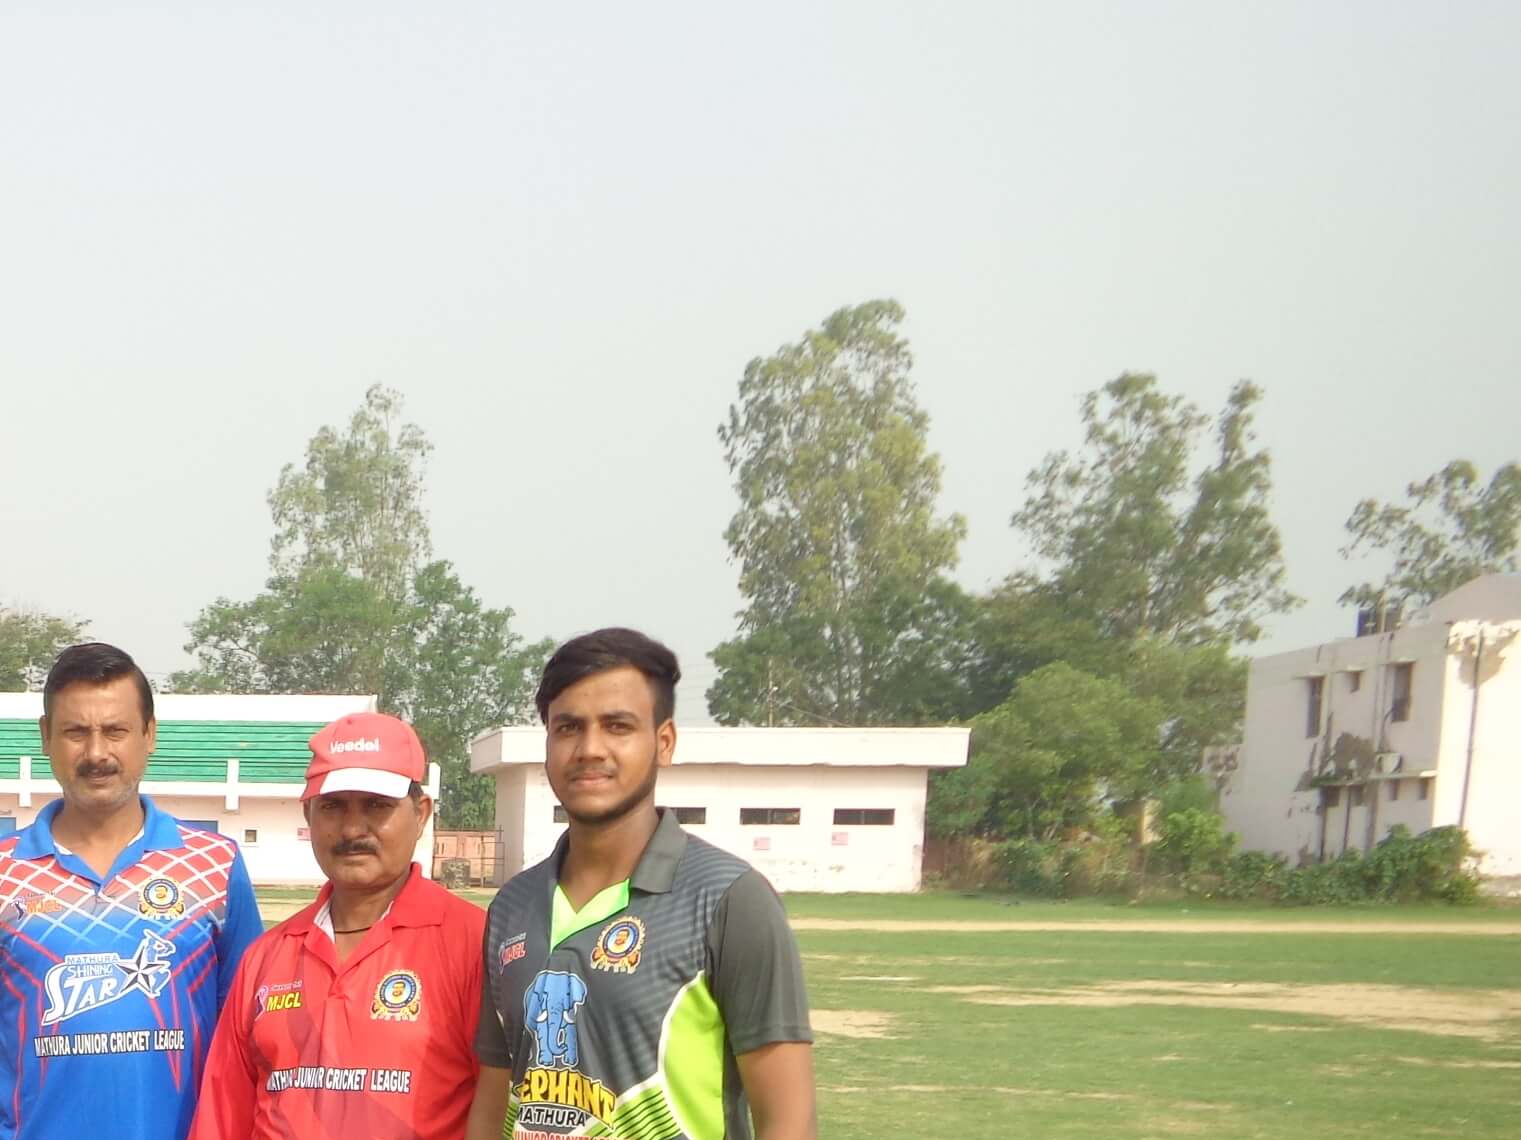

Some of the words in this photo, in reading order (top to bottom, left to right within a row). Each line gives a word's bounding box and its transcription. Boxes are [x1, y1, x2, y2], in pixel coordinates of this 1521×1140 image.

[45, 965, 120, 1024] STAR
[266, 992, 302, 1011] MJCL
[72, 1034, 108, 1054] JUNIOR
[110, 1031, 150, 1052] CRICKET
[154, 1031, 185, 1050] LEAGUE
[326, 1068, 368, 1090] CRICKET
[370, 1069, 411, 1093] LEAGUE
